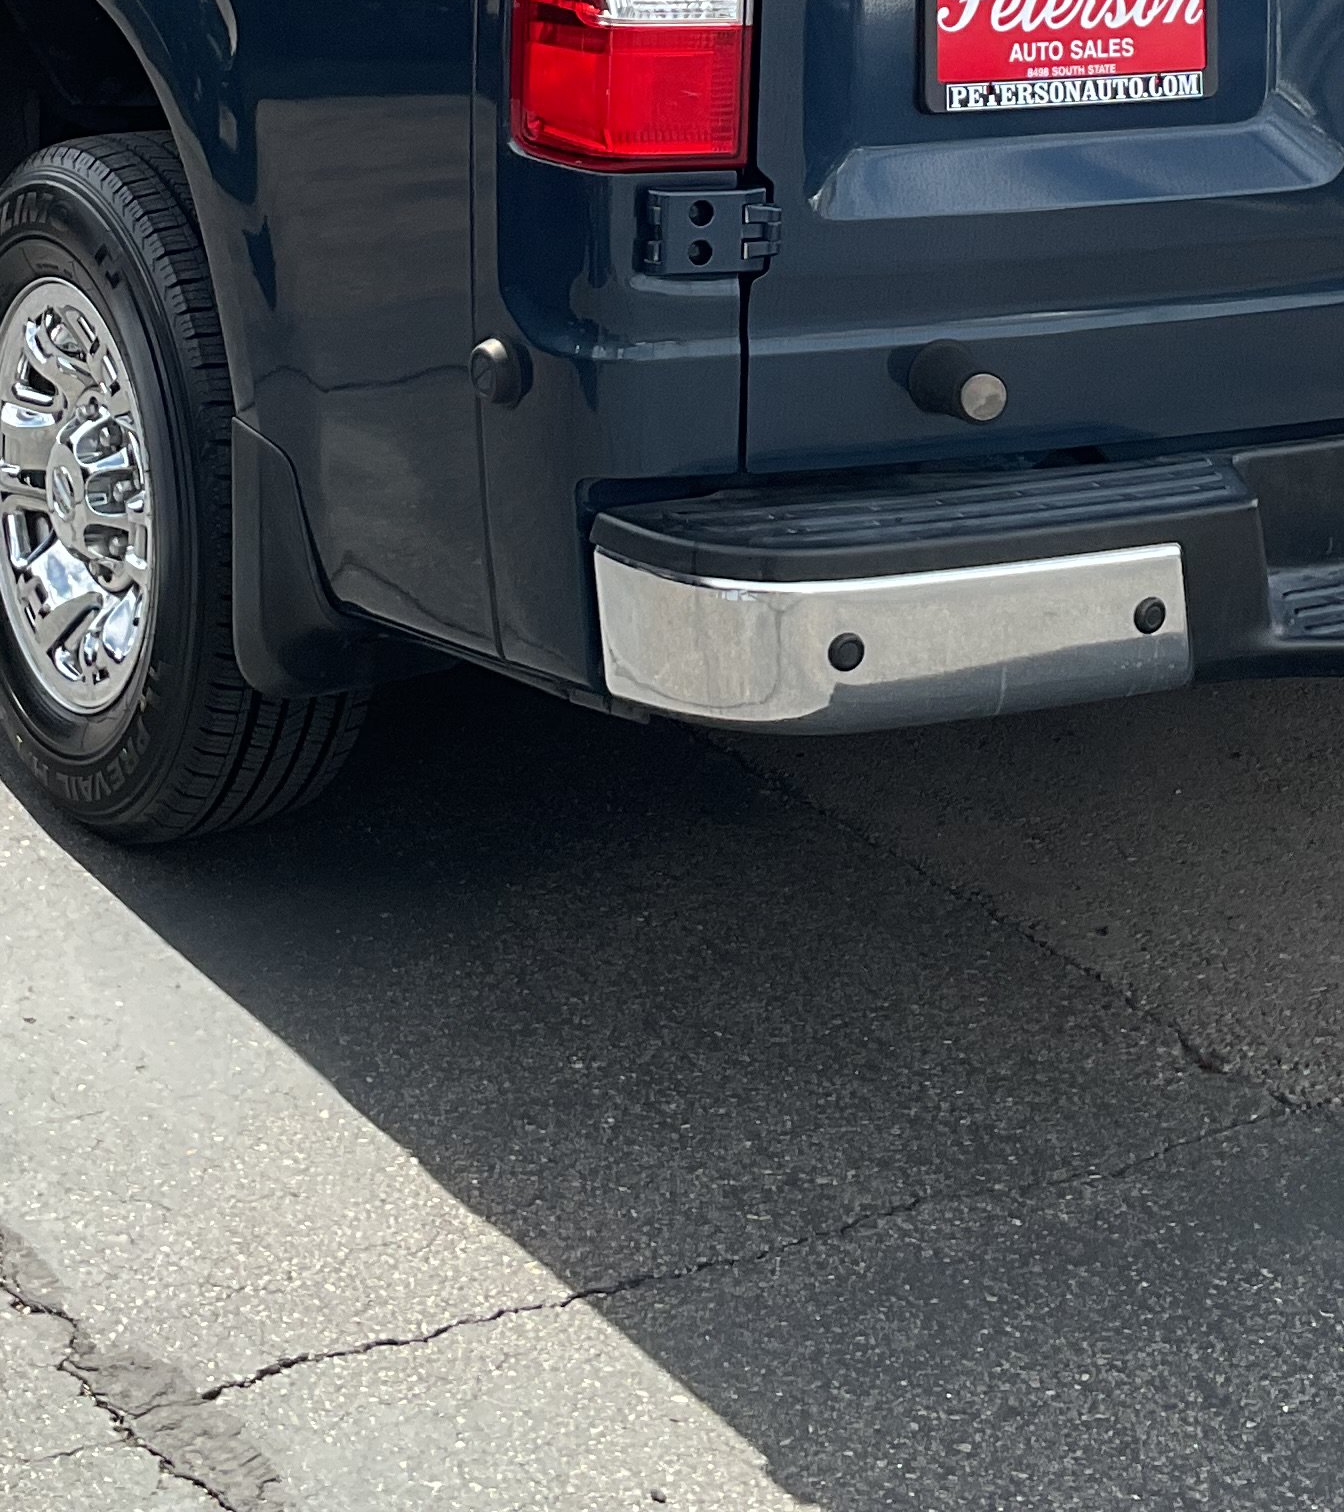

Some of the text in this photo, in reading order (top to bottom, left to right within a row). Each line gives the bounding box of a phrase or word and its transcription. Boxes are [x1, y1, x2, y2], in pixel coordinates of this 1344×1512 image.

[1009, 37, 1135, 63] AUTO SALES
[1051, 65, 1086, 77] SOUTH
[1087, 63, 1116, 75] STATE
